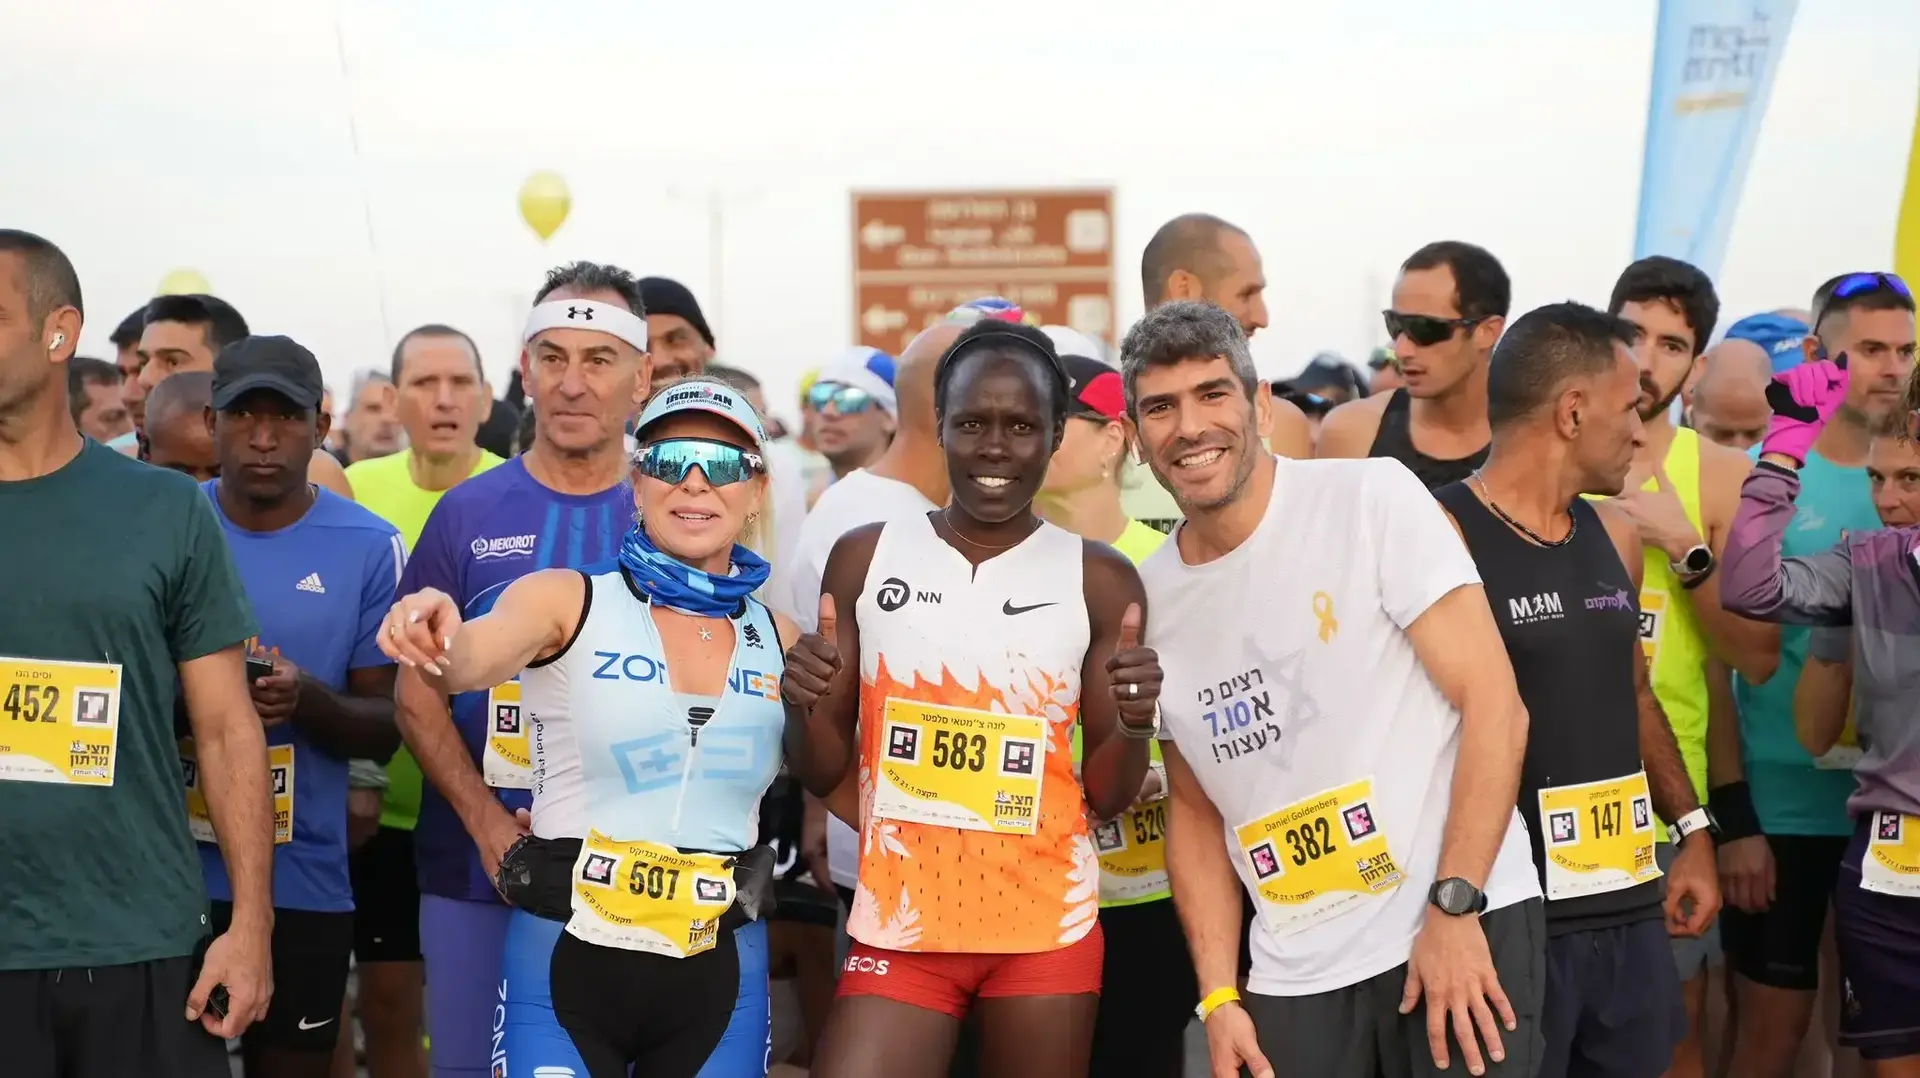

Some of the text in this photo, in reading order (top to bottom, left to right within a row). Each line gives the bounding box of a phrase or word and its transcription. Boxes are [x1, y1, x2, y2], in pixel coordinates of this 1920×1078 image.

[489, 535, 536, 551] MEKOROT
[295, 583, 325, 594] adidas
[916, 591, 942, 604] NN
[1198, 668, 1263, 706] רצים כי
[3, 683, 60, 723] 452
[920, 713, 949, 724] סלפטר
[987, 720, 1006, 731] לונה
[932, 729, 987, 772] 583
[1212, 722, 1281, 763] לעצור!
[70, 754, 109, 767] מרתון
[900, 780, 915, 793] 21.1
[1011, 795, 1034, 806] חצי
[994, 804, 1031, 817] מרתון
[1265, 797, 1339, 832] Daniel Goldenberg
[1591, 801, 1621, 839] 147
[1285, 817, 1336, 867] 382
[1370, 852, 1391, 868] חצי
[629, 860, 680, 901] 507
[1361, 862, 1396, 884] מרתון
[844, 956, 890, 976] NEOS
